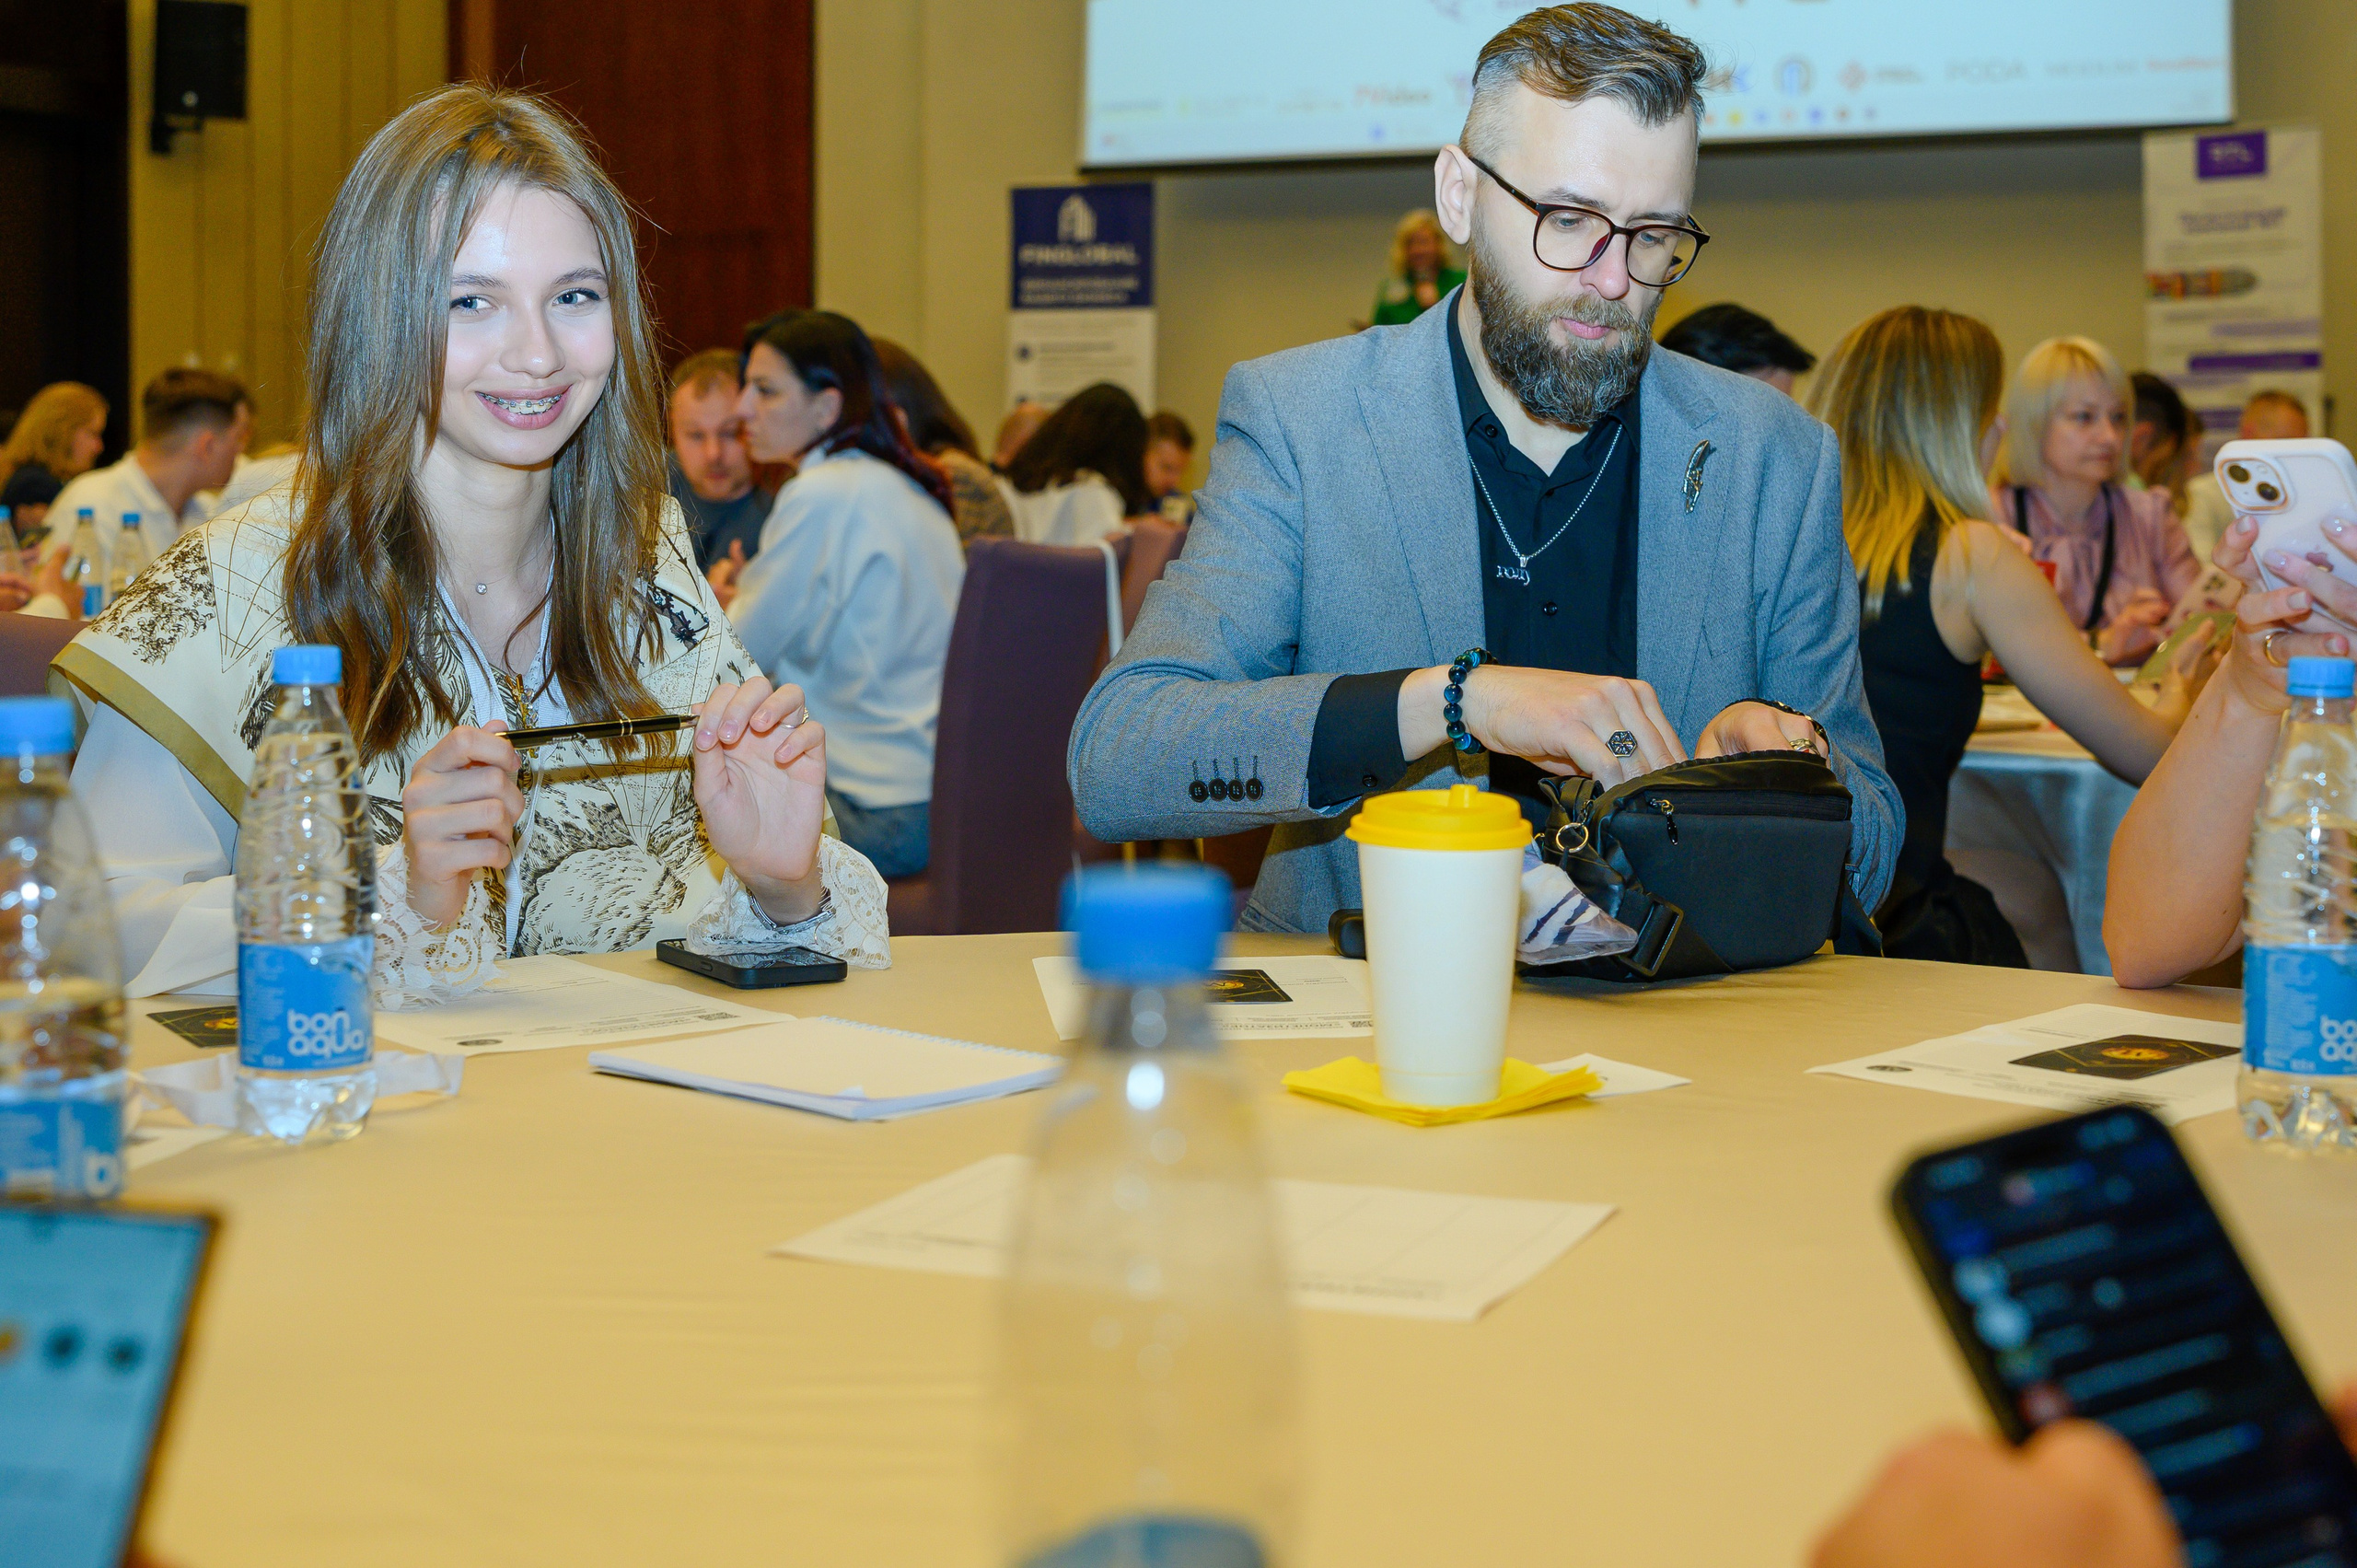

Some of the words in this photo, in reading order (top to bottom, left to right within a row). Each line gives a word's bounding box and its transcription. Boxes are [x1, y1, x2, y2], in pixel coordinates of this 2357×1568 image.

[287, 1009, 350, 1035] bon
[2319, 1014, 2357, 1041] bo
[287, 1029, 365, 1058] aqua
